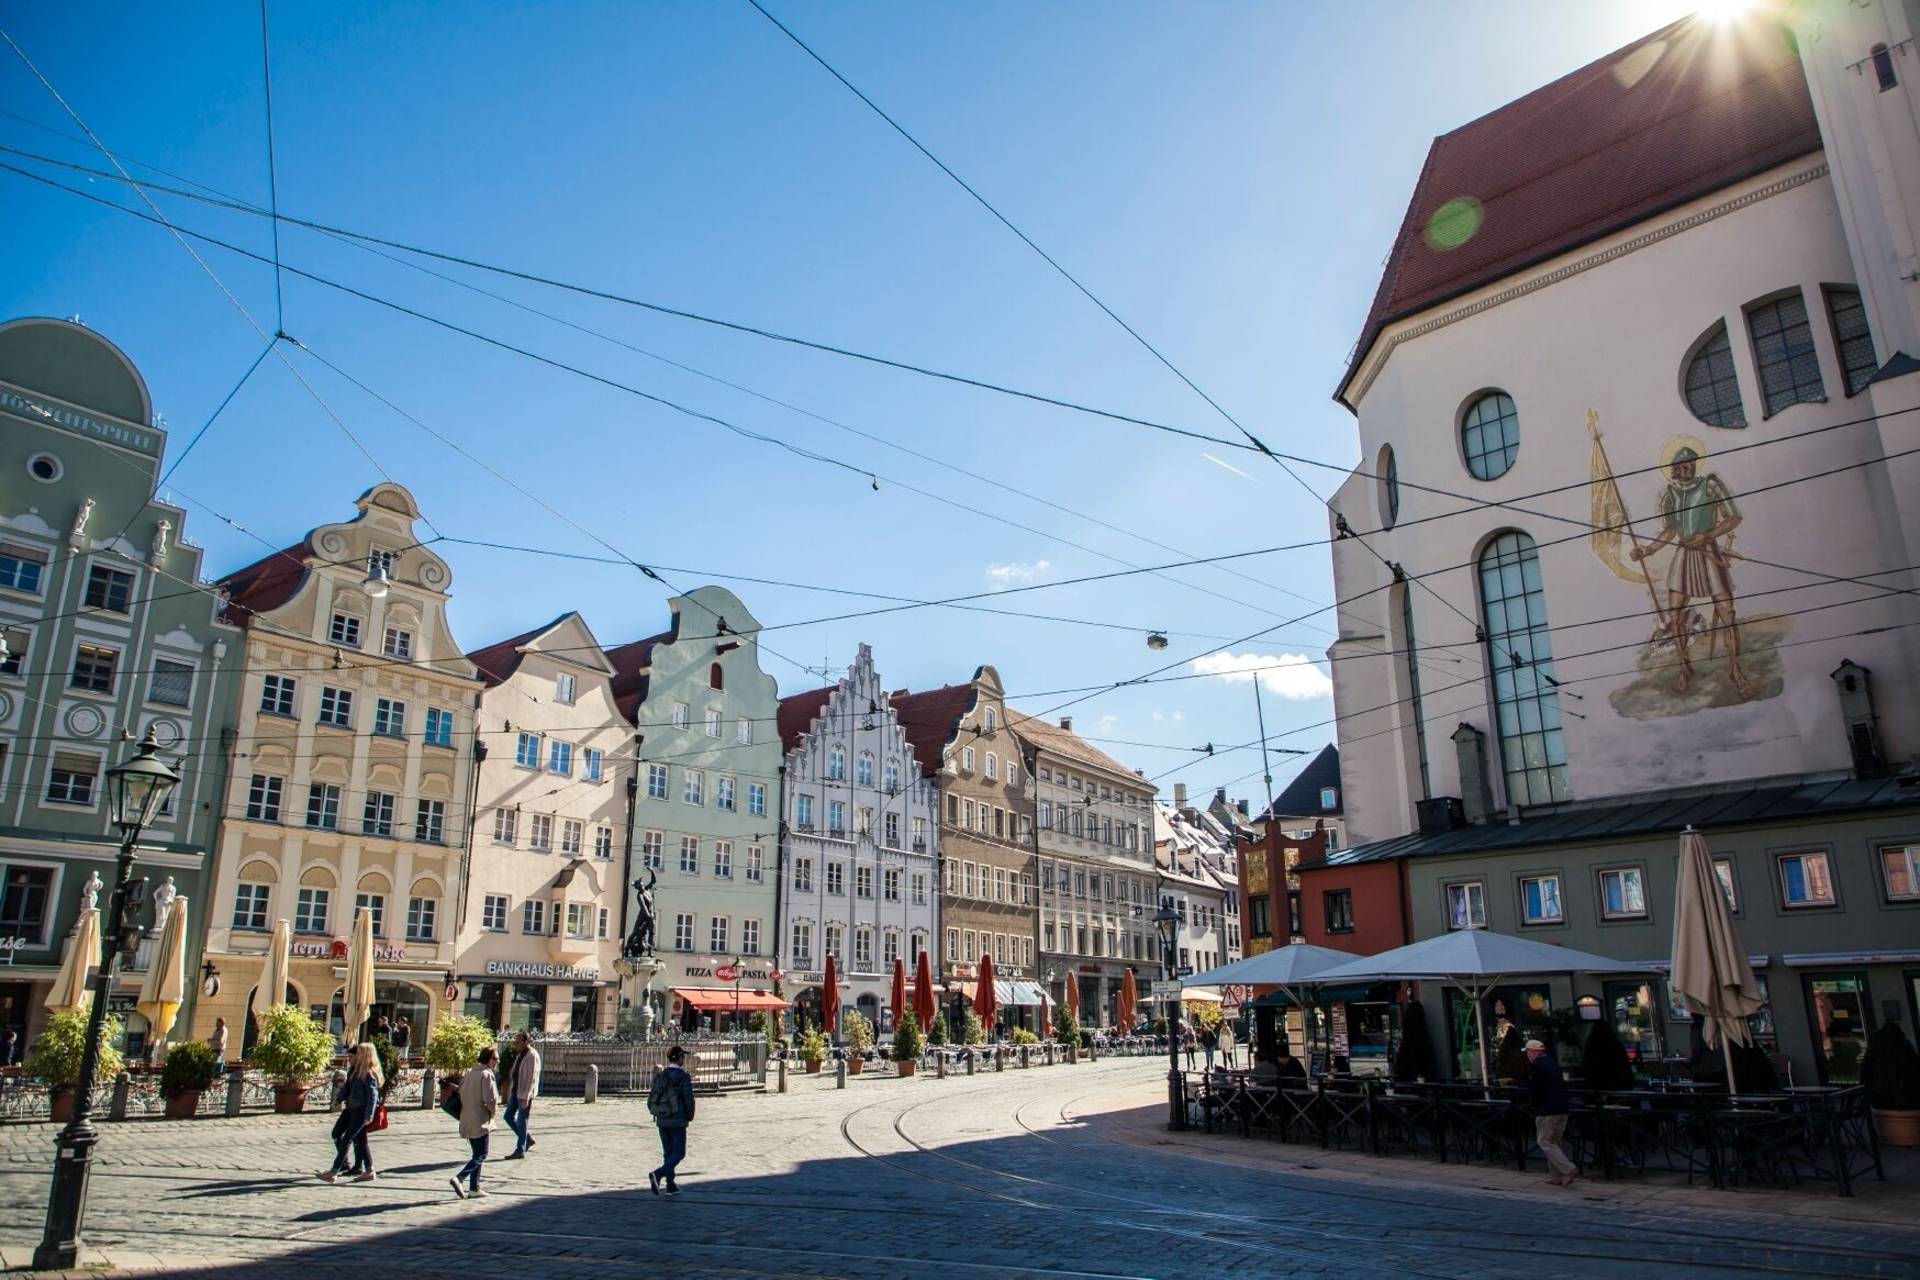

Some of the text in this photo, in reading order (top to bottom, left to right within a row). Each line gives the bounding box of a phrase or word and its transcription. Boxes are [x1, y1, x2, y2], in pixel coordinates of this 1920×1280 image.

[487, 961, 600, 980] BANKHAUS HAFNER
[686, 967, 712, 977] PIZZA
[742, 970, 767, 980] PASTA
